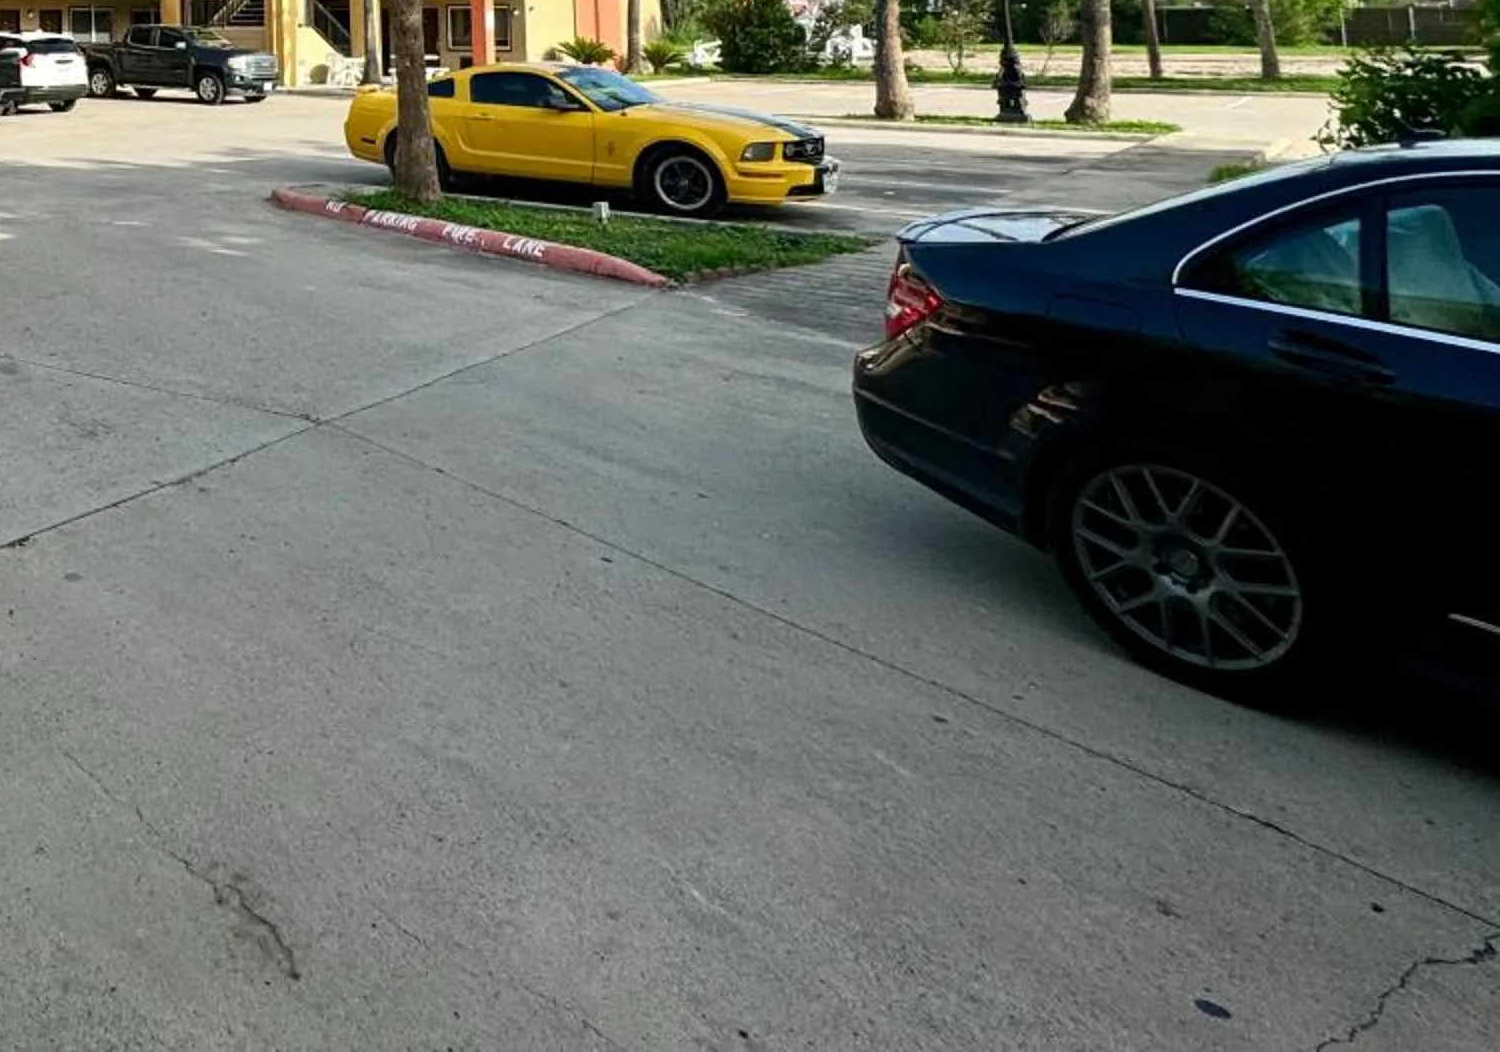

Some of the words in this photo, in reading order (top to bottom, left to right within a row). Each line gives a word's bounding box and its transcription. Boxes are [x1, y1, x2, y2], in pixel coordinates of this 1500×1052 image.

[325, 201, 347, 213] NO
[363, 210, 420, 230] PARKING
[442, 223, 477, 245] FIRE
[503, 235, 546, 257] LANE
